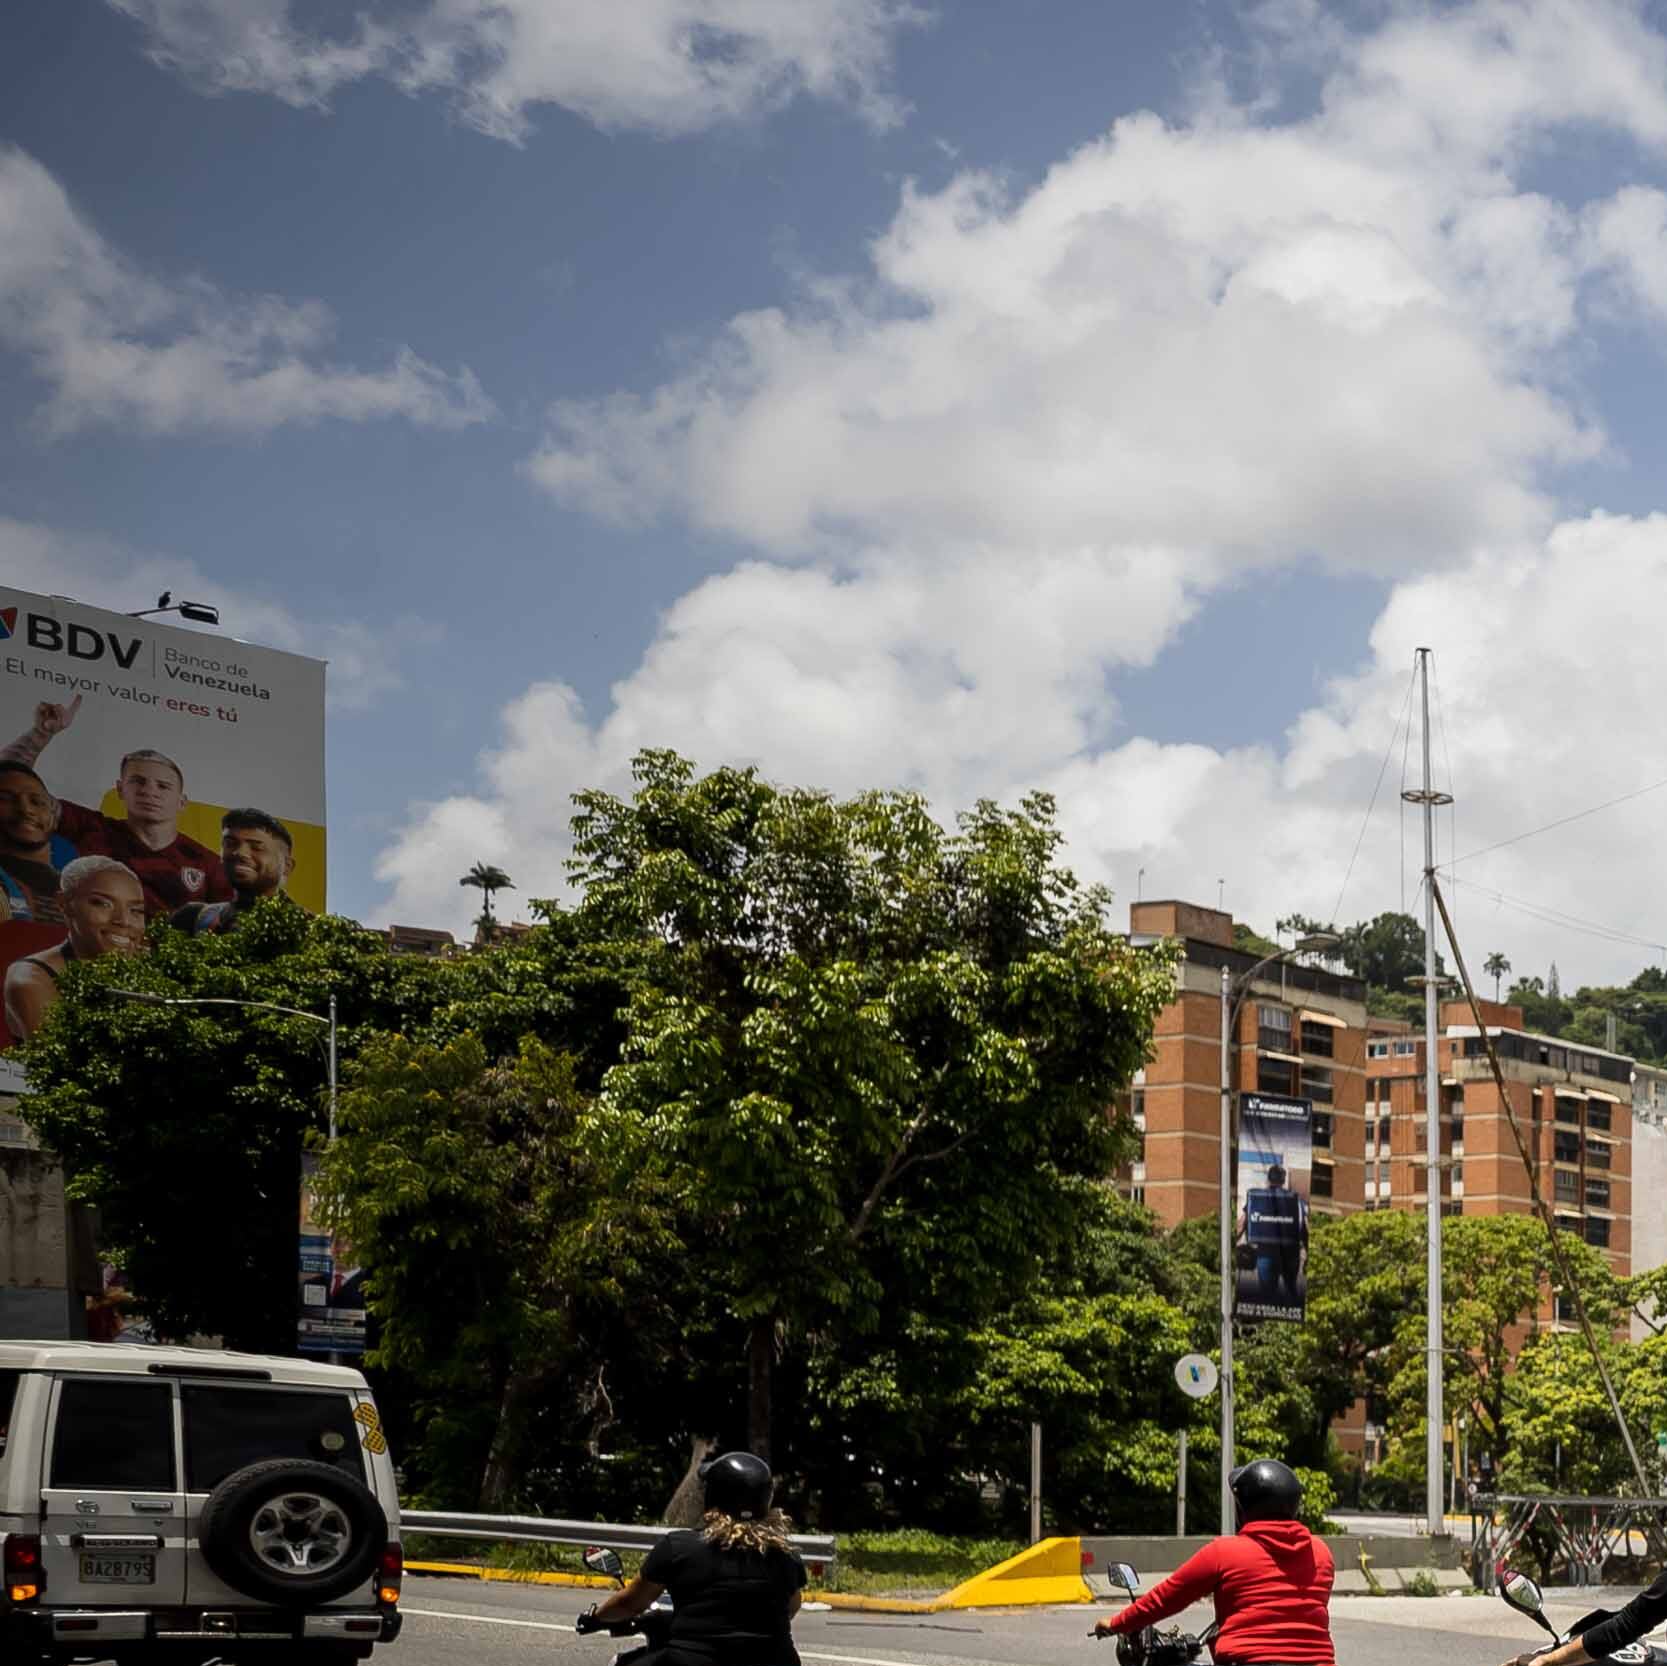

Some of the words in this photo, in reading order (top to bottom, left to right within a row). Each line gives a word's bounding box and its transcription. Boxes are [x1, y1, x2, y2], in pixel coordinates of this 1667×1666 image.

[27, 613, 142, 670] BDV
[165, 647, 221, 672] Banco
[226, 659, 249, 678] de
[6, 657, 27, 676] El
[34, 668, 101, 693] mayor
[107, 684, 160, 705] valor
[166, 698, 210, 717] eres
[217, 706, 239, 723] tú
[165, 663, 271, 700] Venezuela
